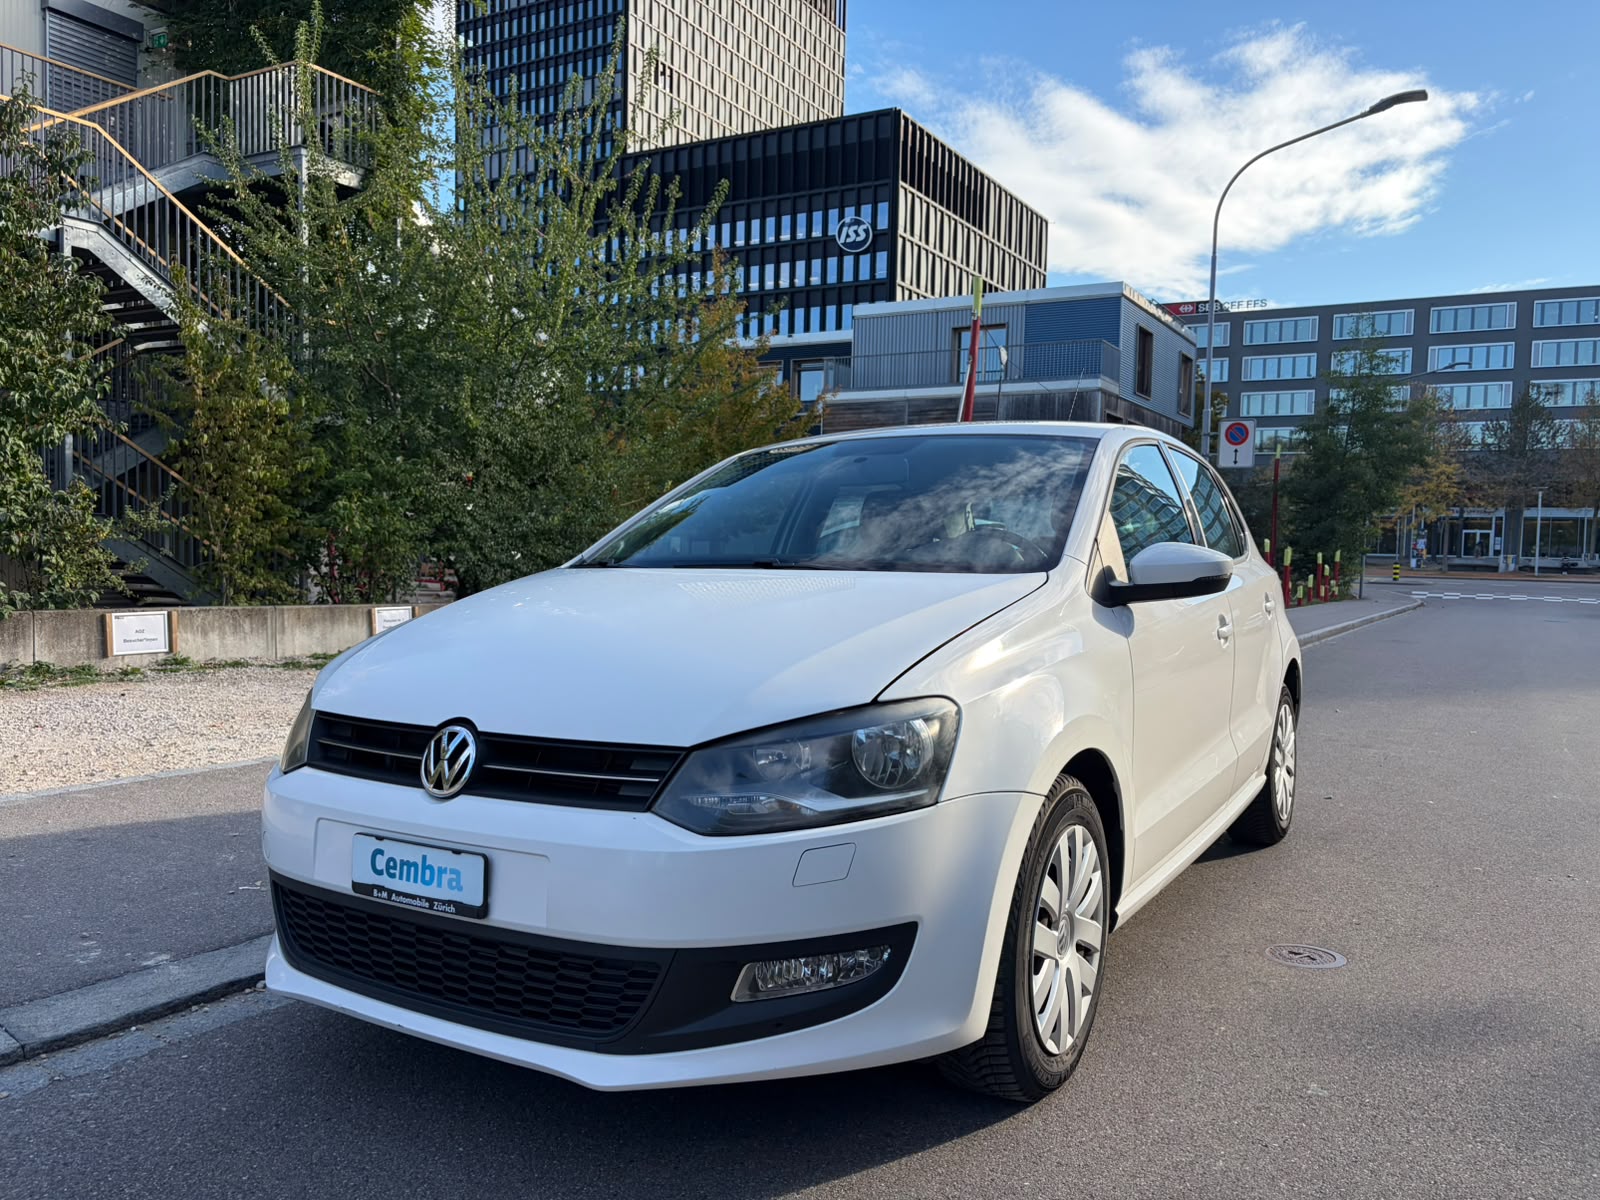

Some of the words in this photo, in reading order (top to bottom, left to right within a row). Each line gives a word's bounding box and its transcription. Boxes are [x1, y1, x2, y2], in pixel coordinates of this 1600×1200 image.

[839, 224, 868, 243] ISS
[424, 727, 475, 795] VW
[370, 847, 463, 892] Cembra
[373, 889, 388, 899] B+M
[391, 893, 430, 908] Automobile
[433, 901, 456, 913] Zürich
